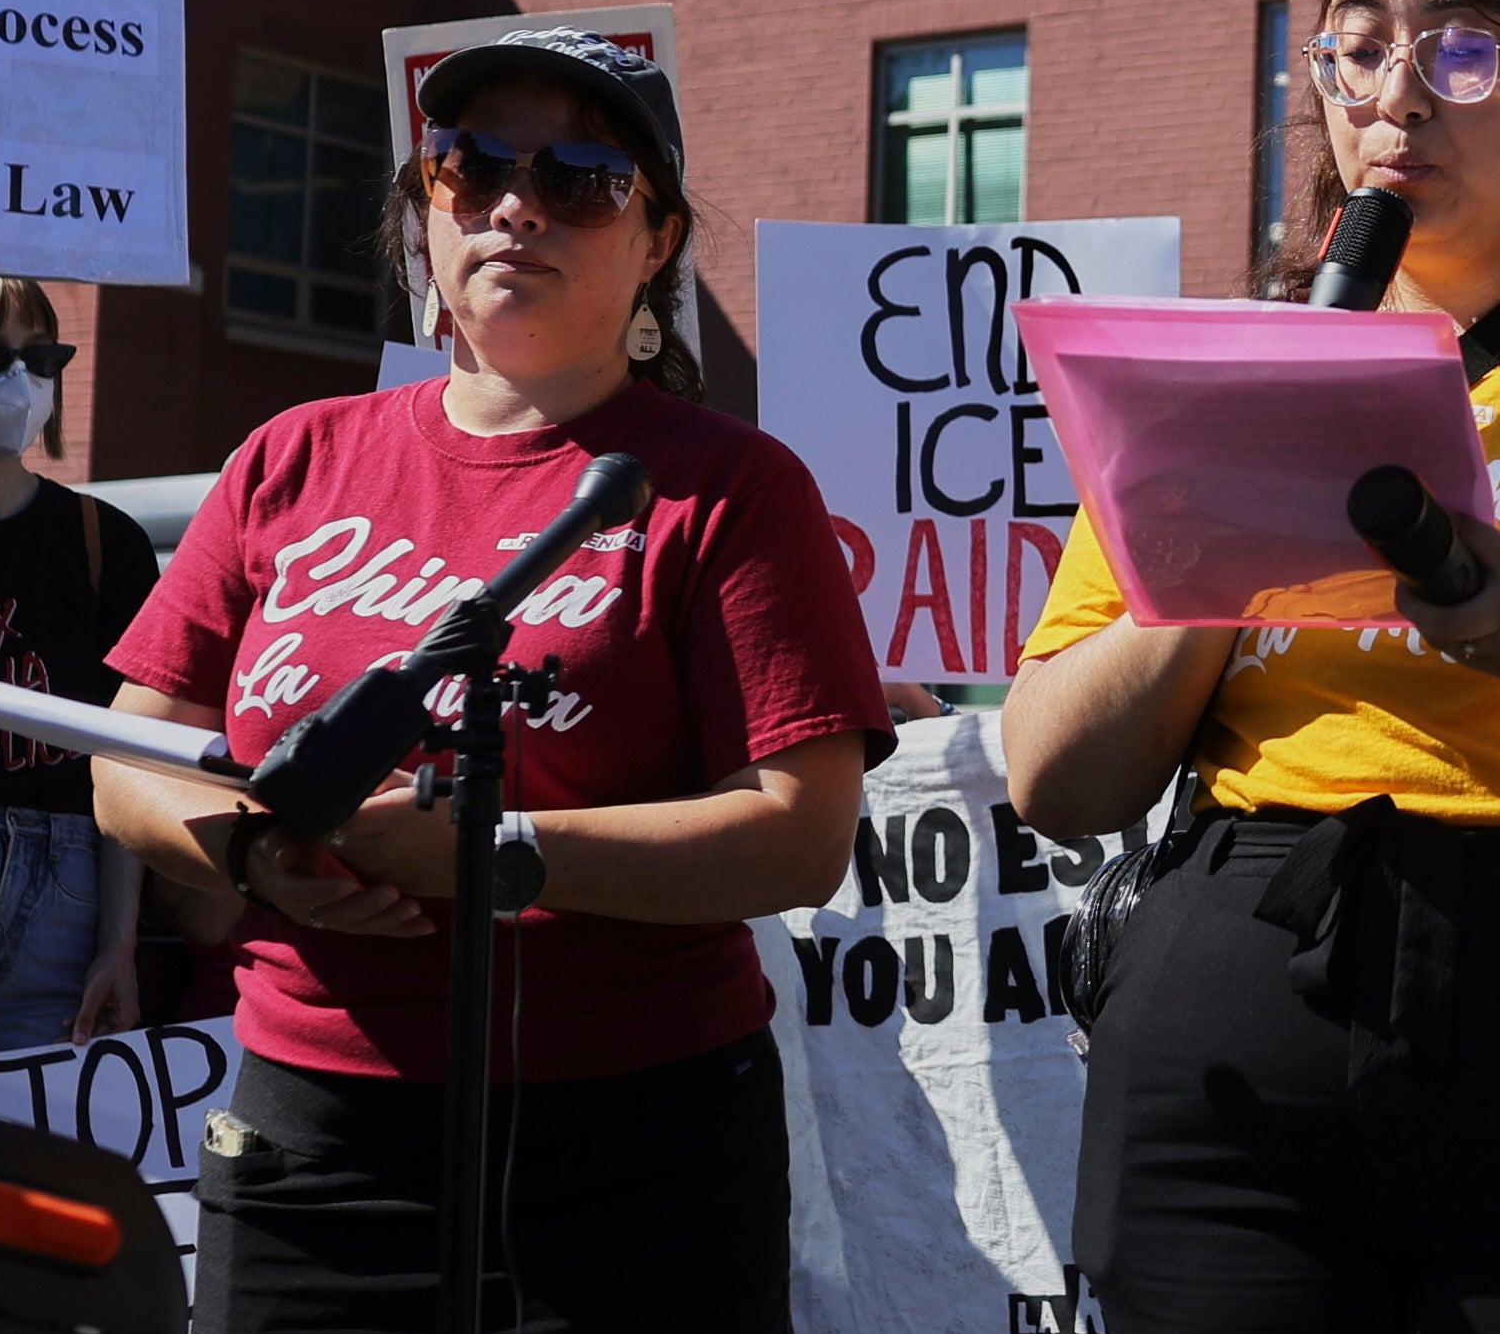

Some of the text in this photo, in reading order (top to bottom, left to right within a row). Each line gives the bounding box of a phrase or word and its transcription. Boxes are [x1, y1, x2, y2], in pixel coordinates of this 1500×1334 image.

[2, 162, 136, 224] Law
[895, 401, 1080, 518] ICE
[234, 632, 321, 719] La
[852, 805, 971, 909] NO
[792, 934, 957, 1027] YOU
[1017, 1300, 1061, 1334] LA
